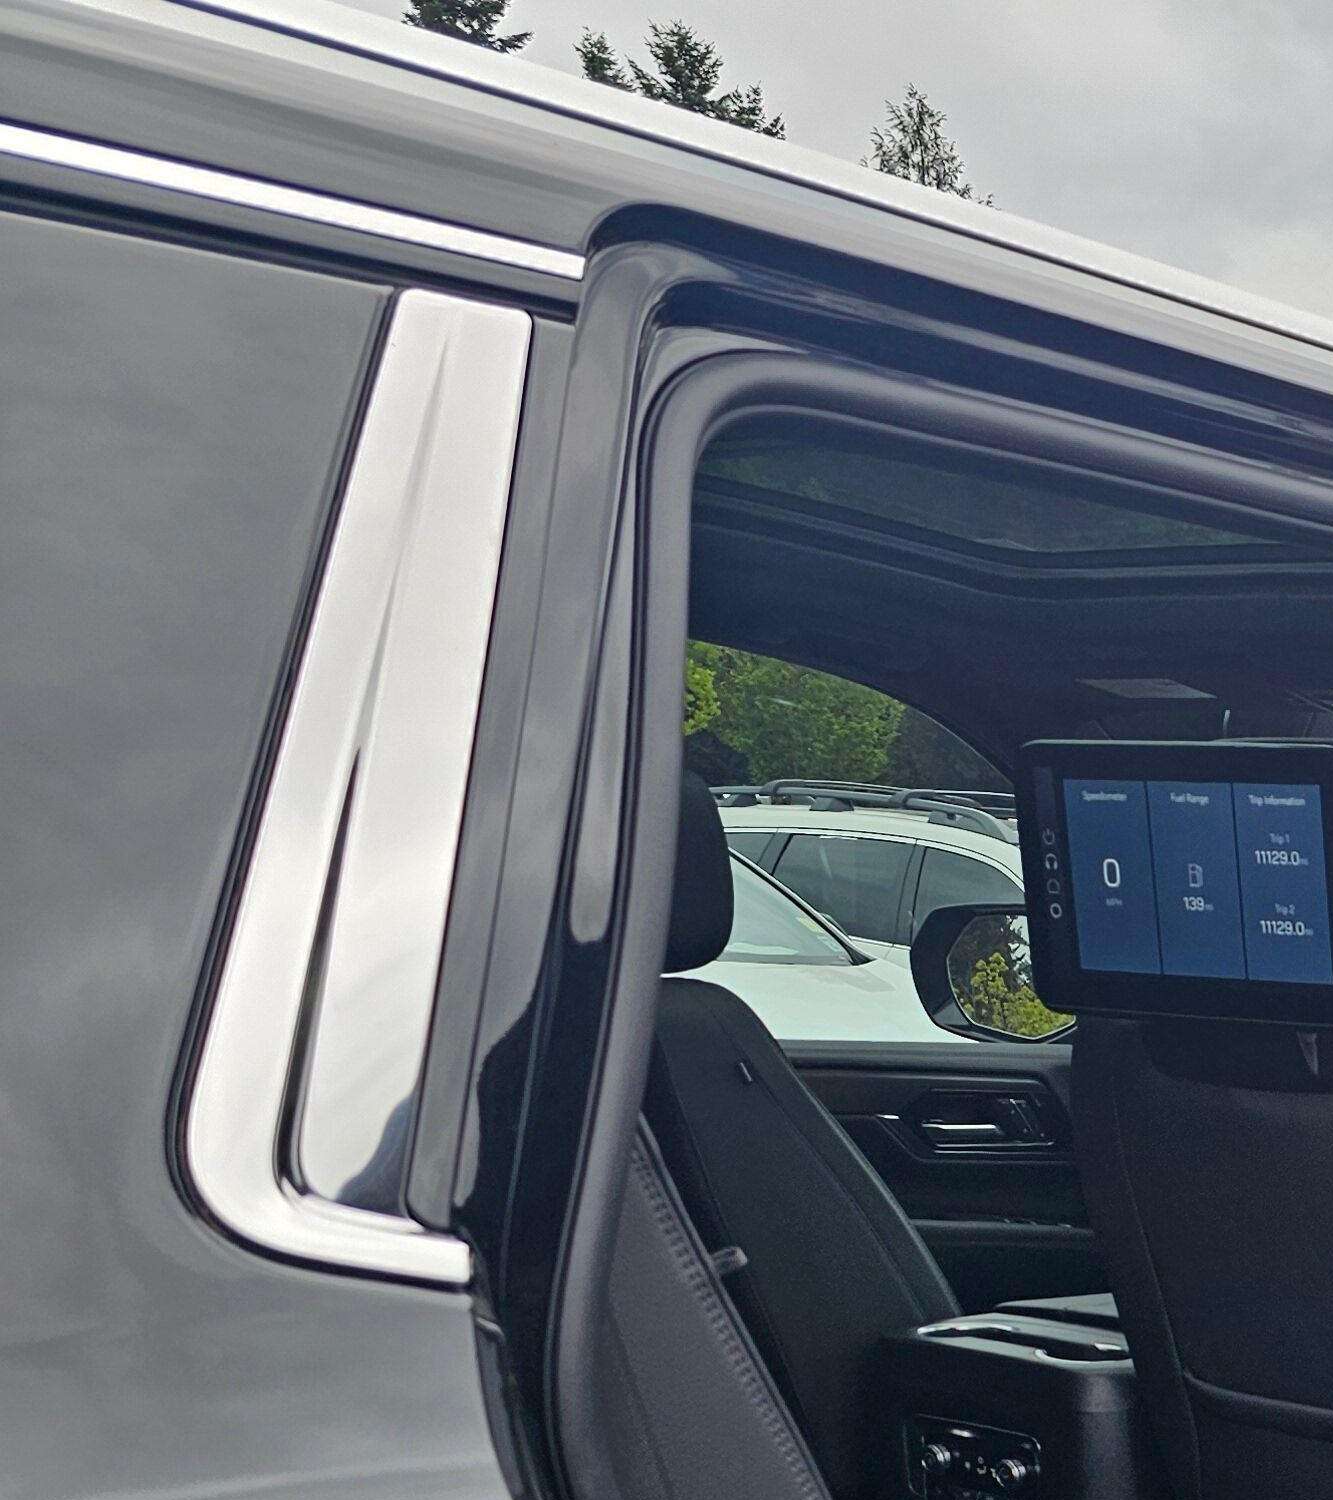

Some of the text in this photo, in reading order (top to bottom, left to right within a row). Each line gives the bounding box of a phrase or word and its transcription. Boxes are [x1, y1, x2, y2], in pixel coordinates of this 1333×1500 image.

[1170, 792, 1186, 802] Fuel
[1248, 794, 1263, 806] Trip
[1269, 833, 1284, 844] Trip
[1103, 858, 1120, 888] 0
[1275, 903, 1288, 916] Trip
